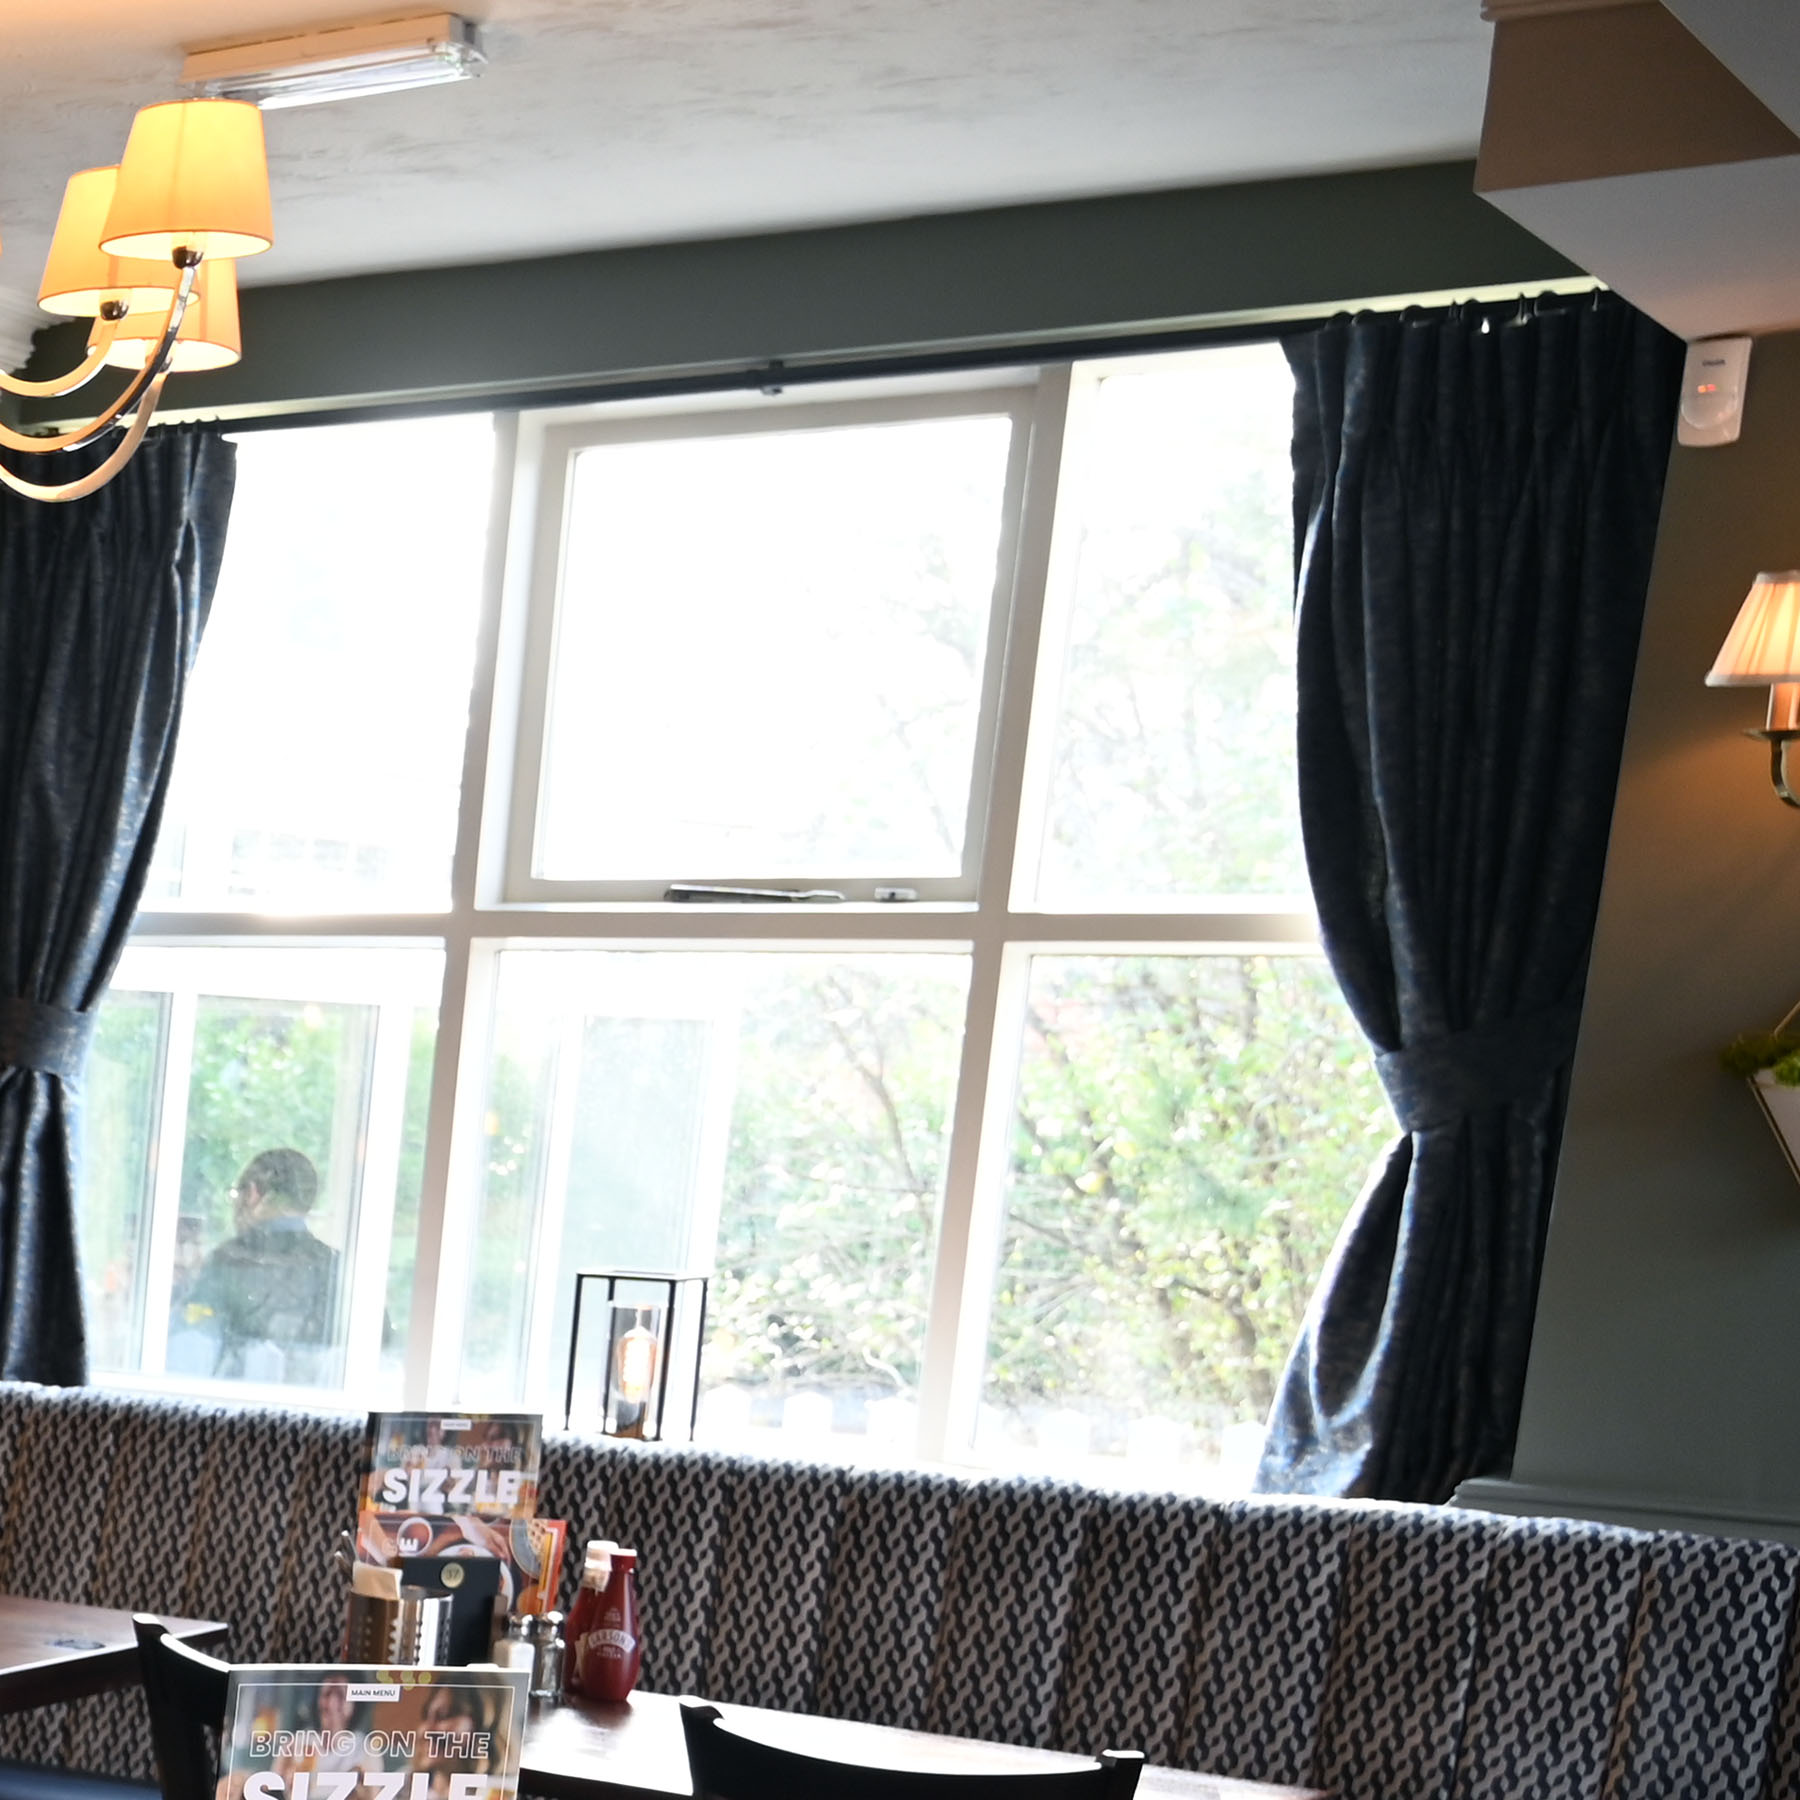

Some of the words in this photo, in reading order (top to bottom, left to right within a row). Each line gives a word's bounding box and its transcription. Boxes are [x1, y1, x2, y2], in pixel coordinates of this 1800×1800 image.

[382, 1468, 521, 1505] SIZZLE
[351, 1689, 371, 1697] MAIN
[372, 1689, 396, 1697] MENU
[250, 1730, 356, 1758] BRING
[364, 1730, 416, 1758] ON
[424, 1731, 491, 1759] THE
